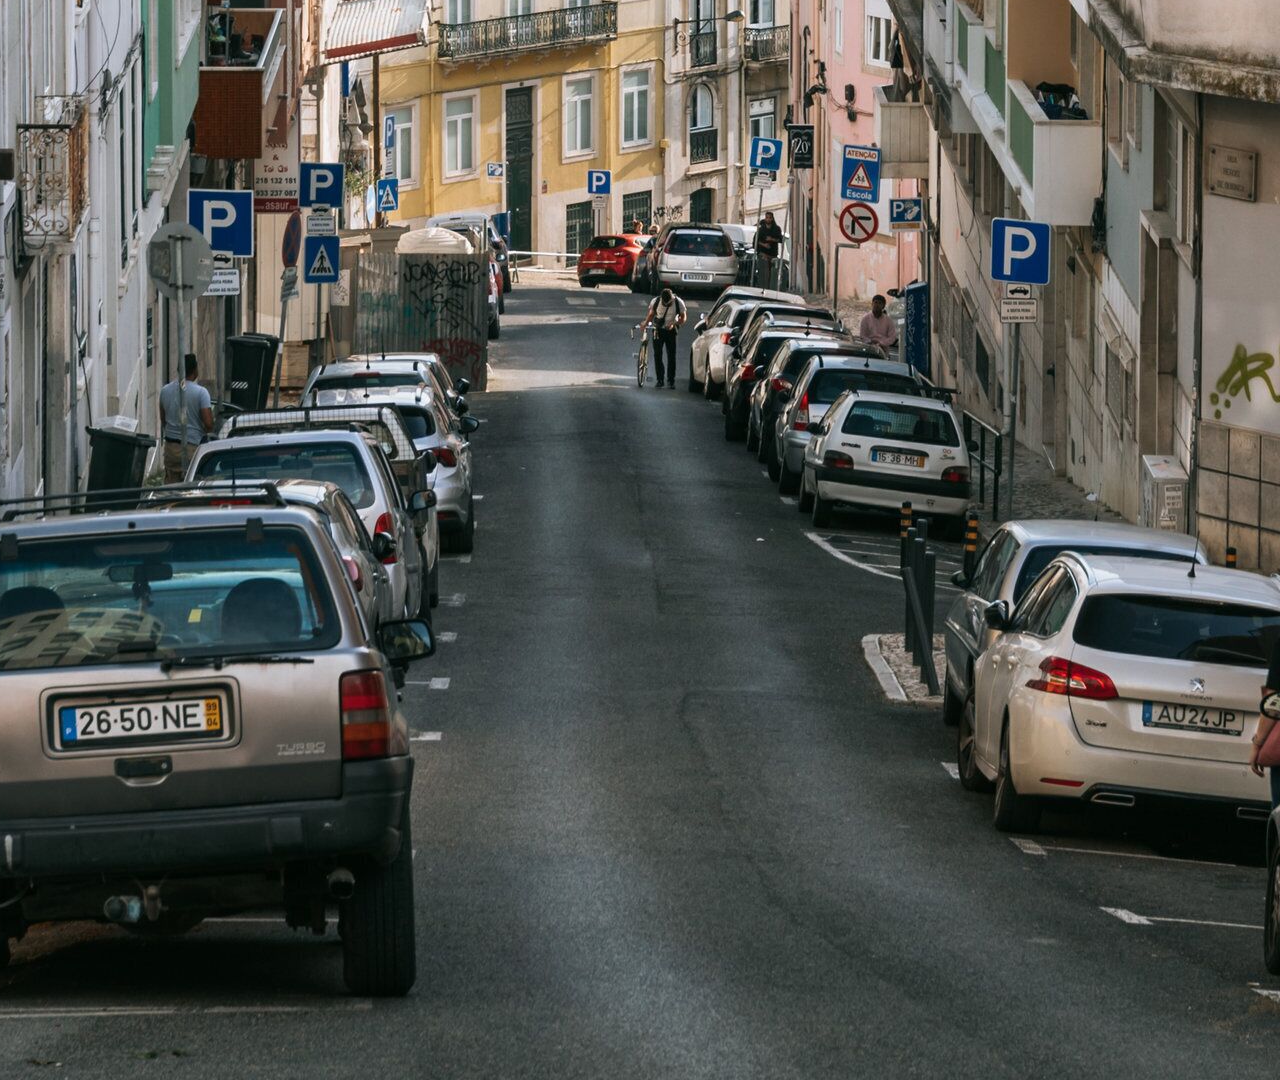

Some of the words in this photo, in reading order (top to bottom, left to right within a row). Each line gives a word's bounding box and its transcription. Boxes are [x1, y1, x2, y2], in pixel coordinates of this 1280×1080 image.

[755, 140, 776, 166] P
[308, 168, 334, 201] P
[592, 172, 607, 192] P
[846, 188, 873, 201] Escola
[892, 201, 905, 218] P
[203, 199, 237, 249] P
[1003, 226, 1037, 276] P
